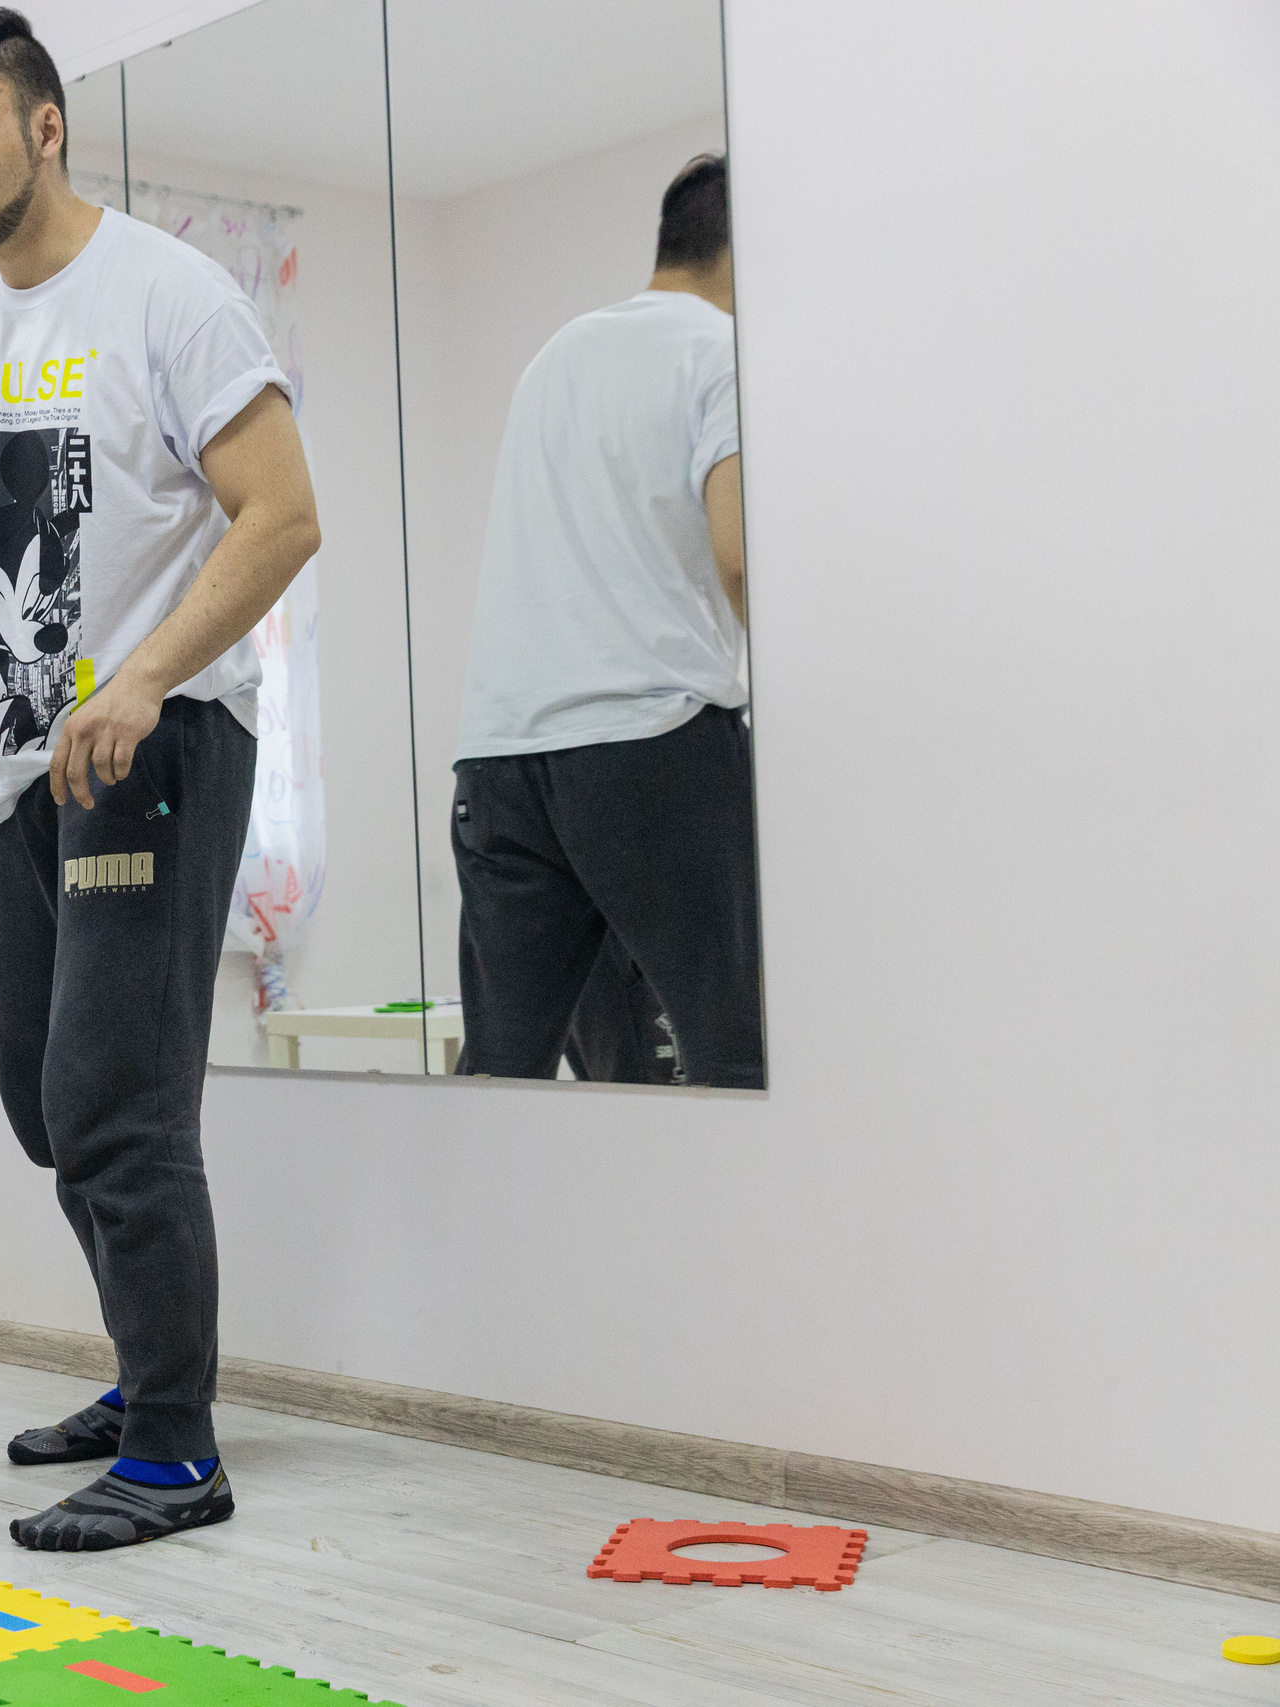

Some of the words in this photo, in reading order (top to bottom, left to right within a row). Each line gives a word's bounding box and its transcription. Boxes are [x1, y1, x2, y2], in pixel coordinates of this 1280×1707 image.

[68, 438, 90, 509] 二十八
[64, 852, 154, 892] PUMA
[68, 886, 147, 898] SPORTSWEAR
